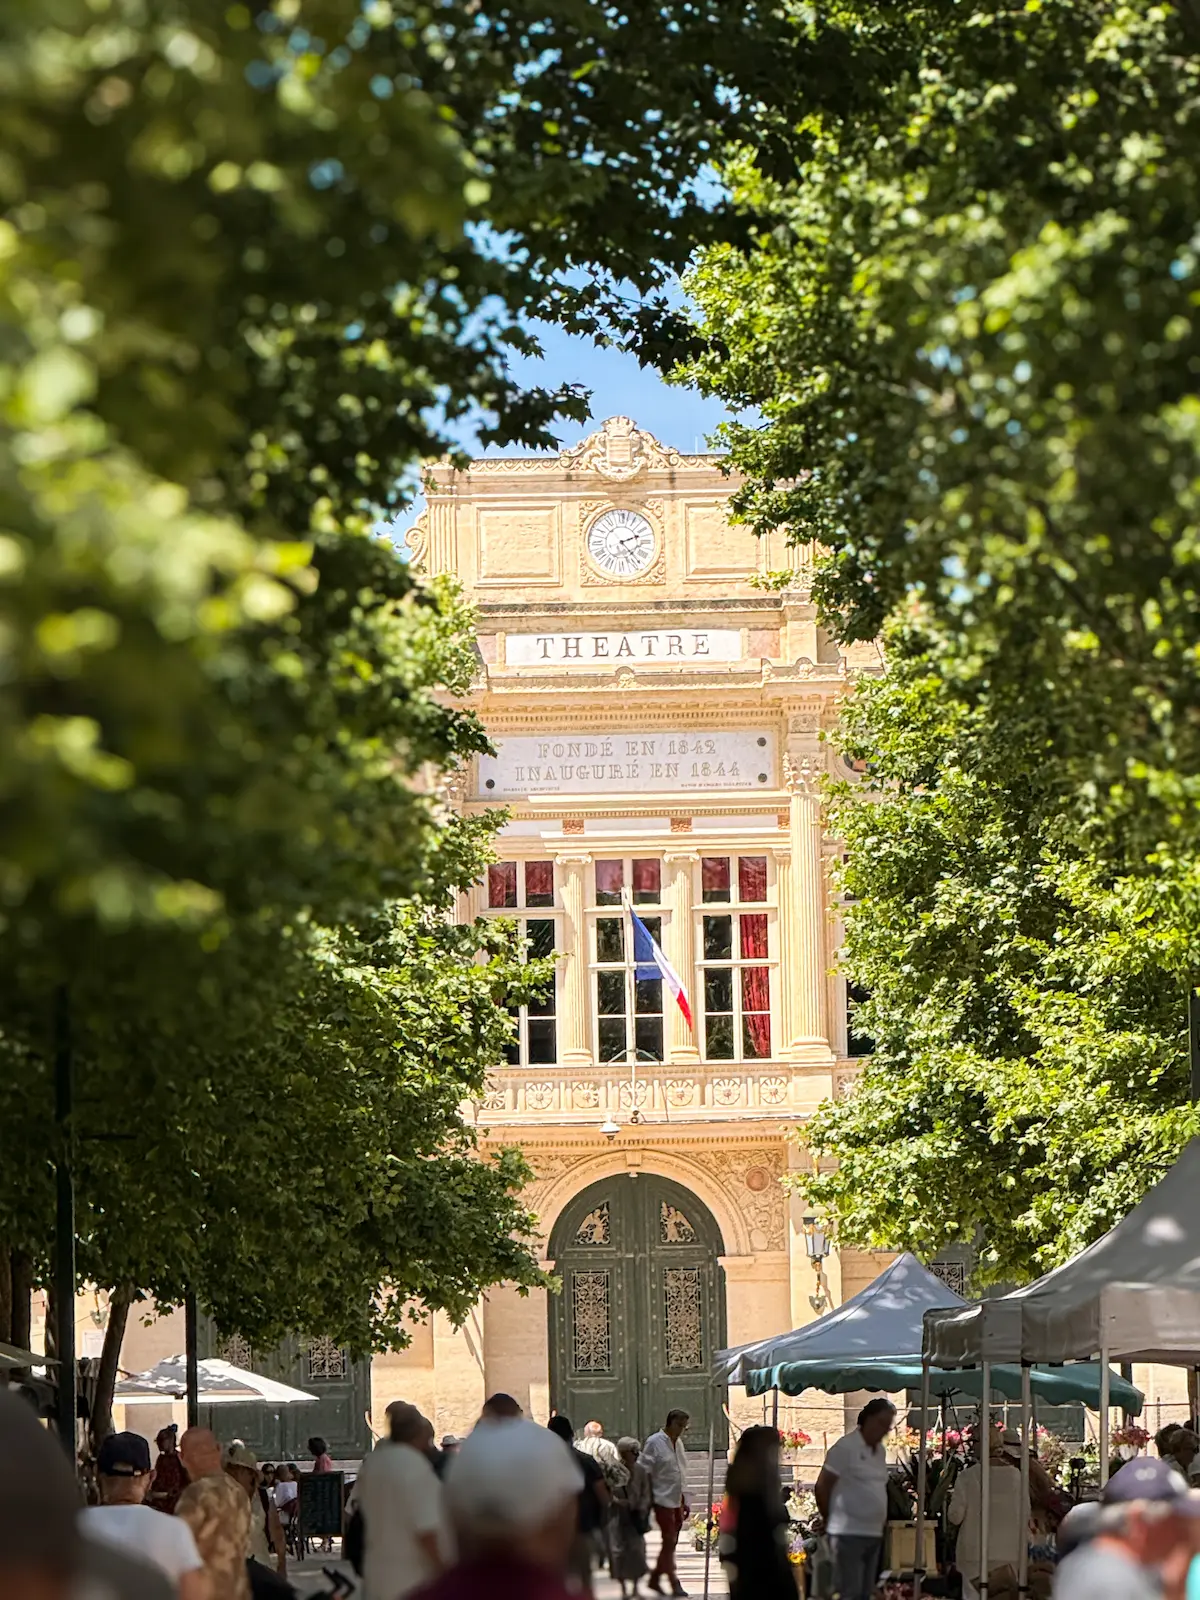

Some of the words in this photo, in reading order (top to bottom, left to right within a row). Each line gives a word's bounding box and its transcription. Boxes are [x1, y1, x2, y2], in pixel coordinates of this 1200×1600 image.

[537, 634, 710, 658] THEATRE
[538, 737, 613, 758] FONDÉ
[626, 741, 655, 756] EN
[668, 740, 716, 755] 1842
[515, 759, 640, 781] INAUGURÉ
[650, 763, 680, 778] EN
[691, 761, 741, 777] 1844
